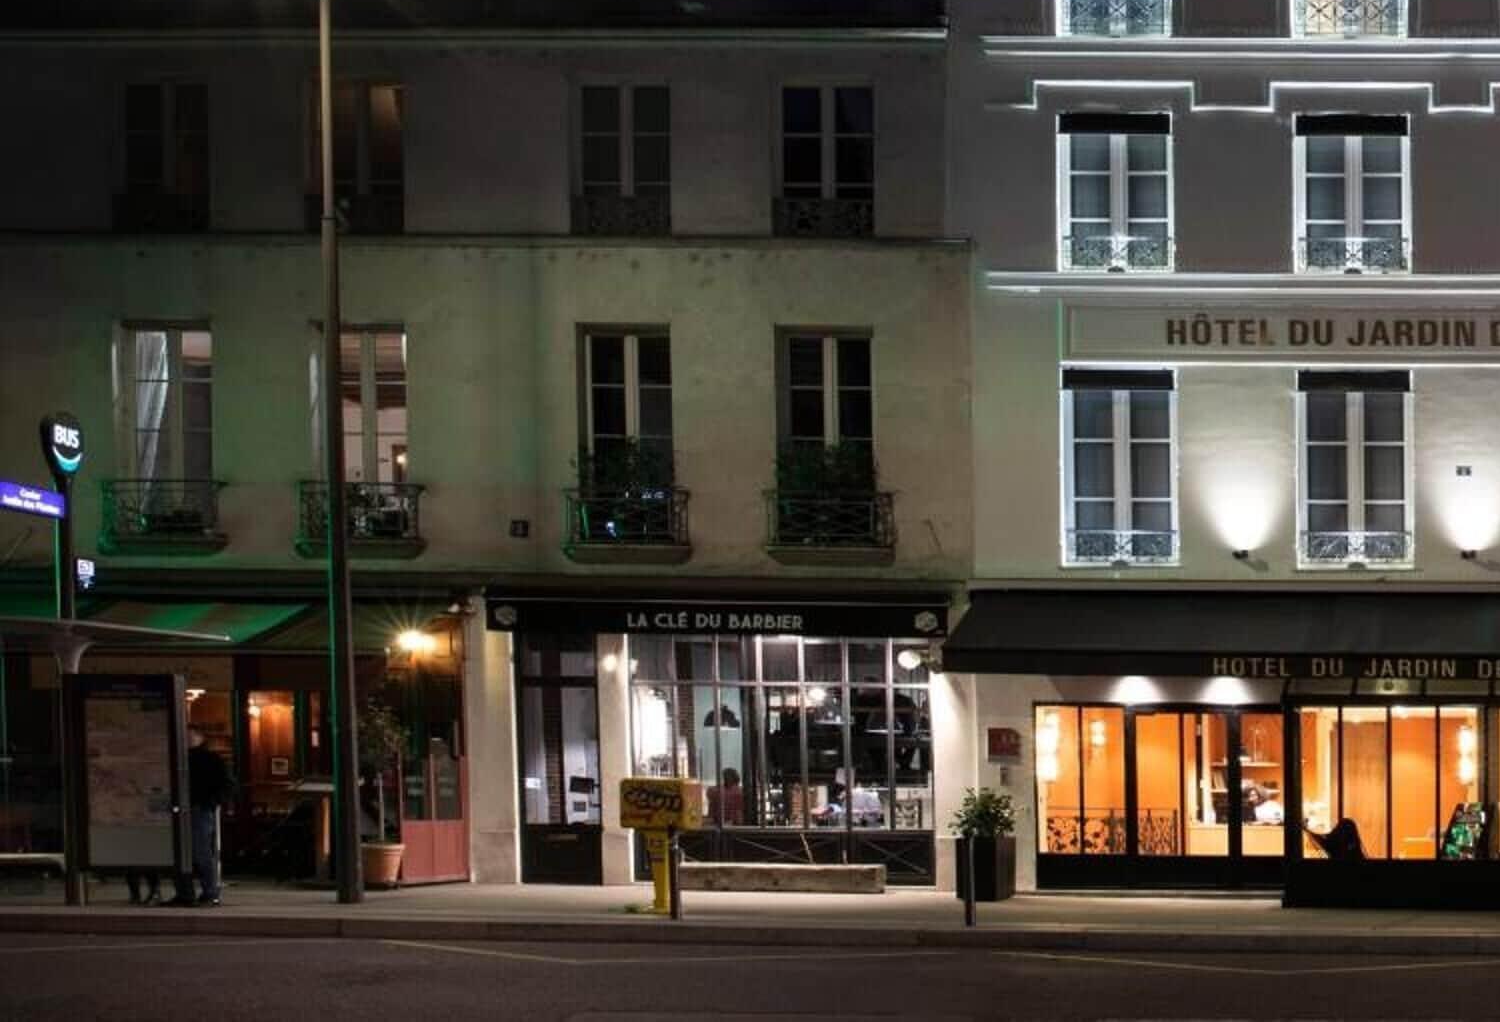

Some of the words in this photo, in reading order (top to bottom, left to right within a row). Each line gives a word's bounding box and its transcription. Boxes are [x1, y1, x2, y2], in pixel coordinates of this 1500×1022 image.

[1167, 313, 1276, 345] HÔTEL
[1288, 319, 1334, 346] DU
[1347, 319, 1476, 347] JARDIN
[54, 424, 80, 448] BUS
[627, 612, 649, 628] LA
[654, 611, 690, 629] CLÉ
[695, 612, 722, 629] DU
[728, 613, 803, 630] BARBIER
[1213, 657, 1292, 677] HOTEL
[1311, 657, 1344, 677] DU
[1364, 657, 1457, 678] JARDIN
